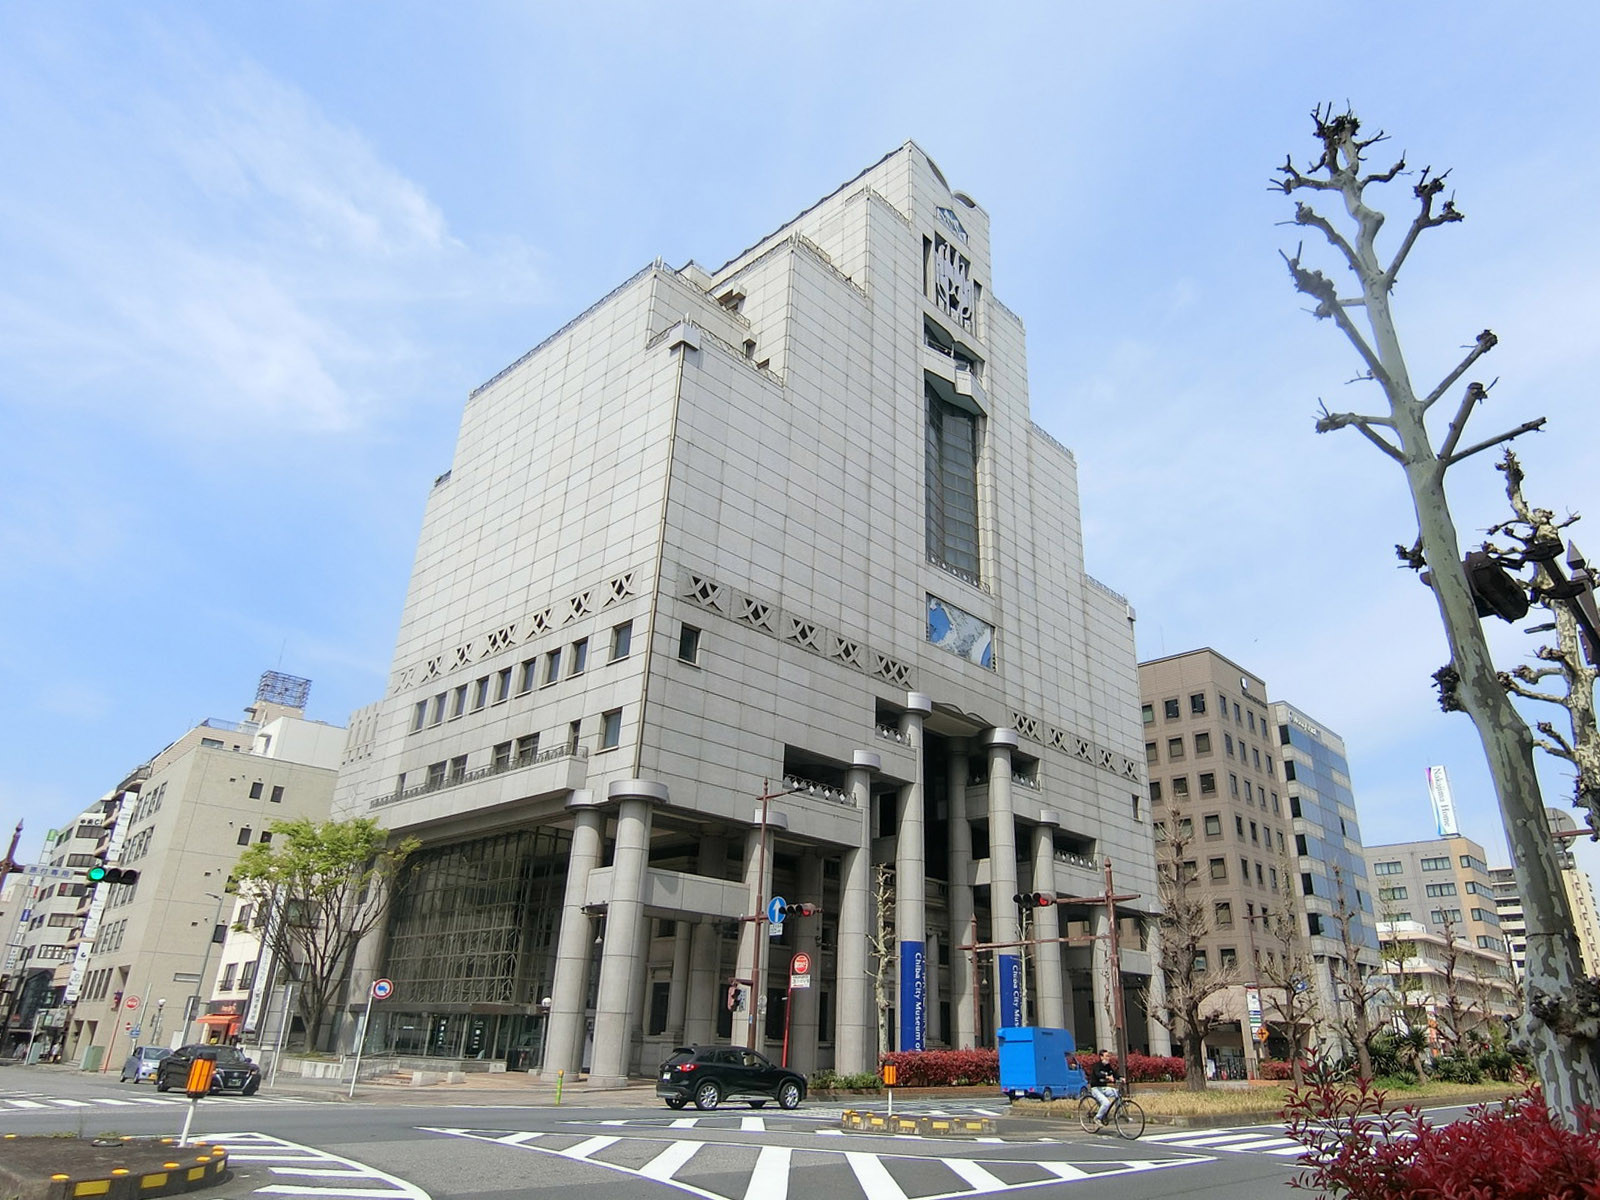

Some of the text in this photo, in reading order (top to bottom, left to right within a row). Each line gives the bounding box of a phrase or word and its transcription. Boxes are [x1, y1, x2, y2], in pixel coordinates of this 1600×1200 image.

[1433, 768, 1450, 827] Nakajima Home
[914, 980, 922, 1000] City
